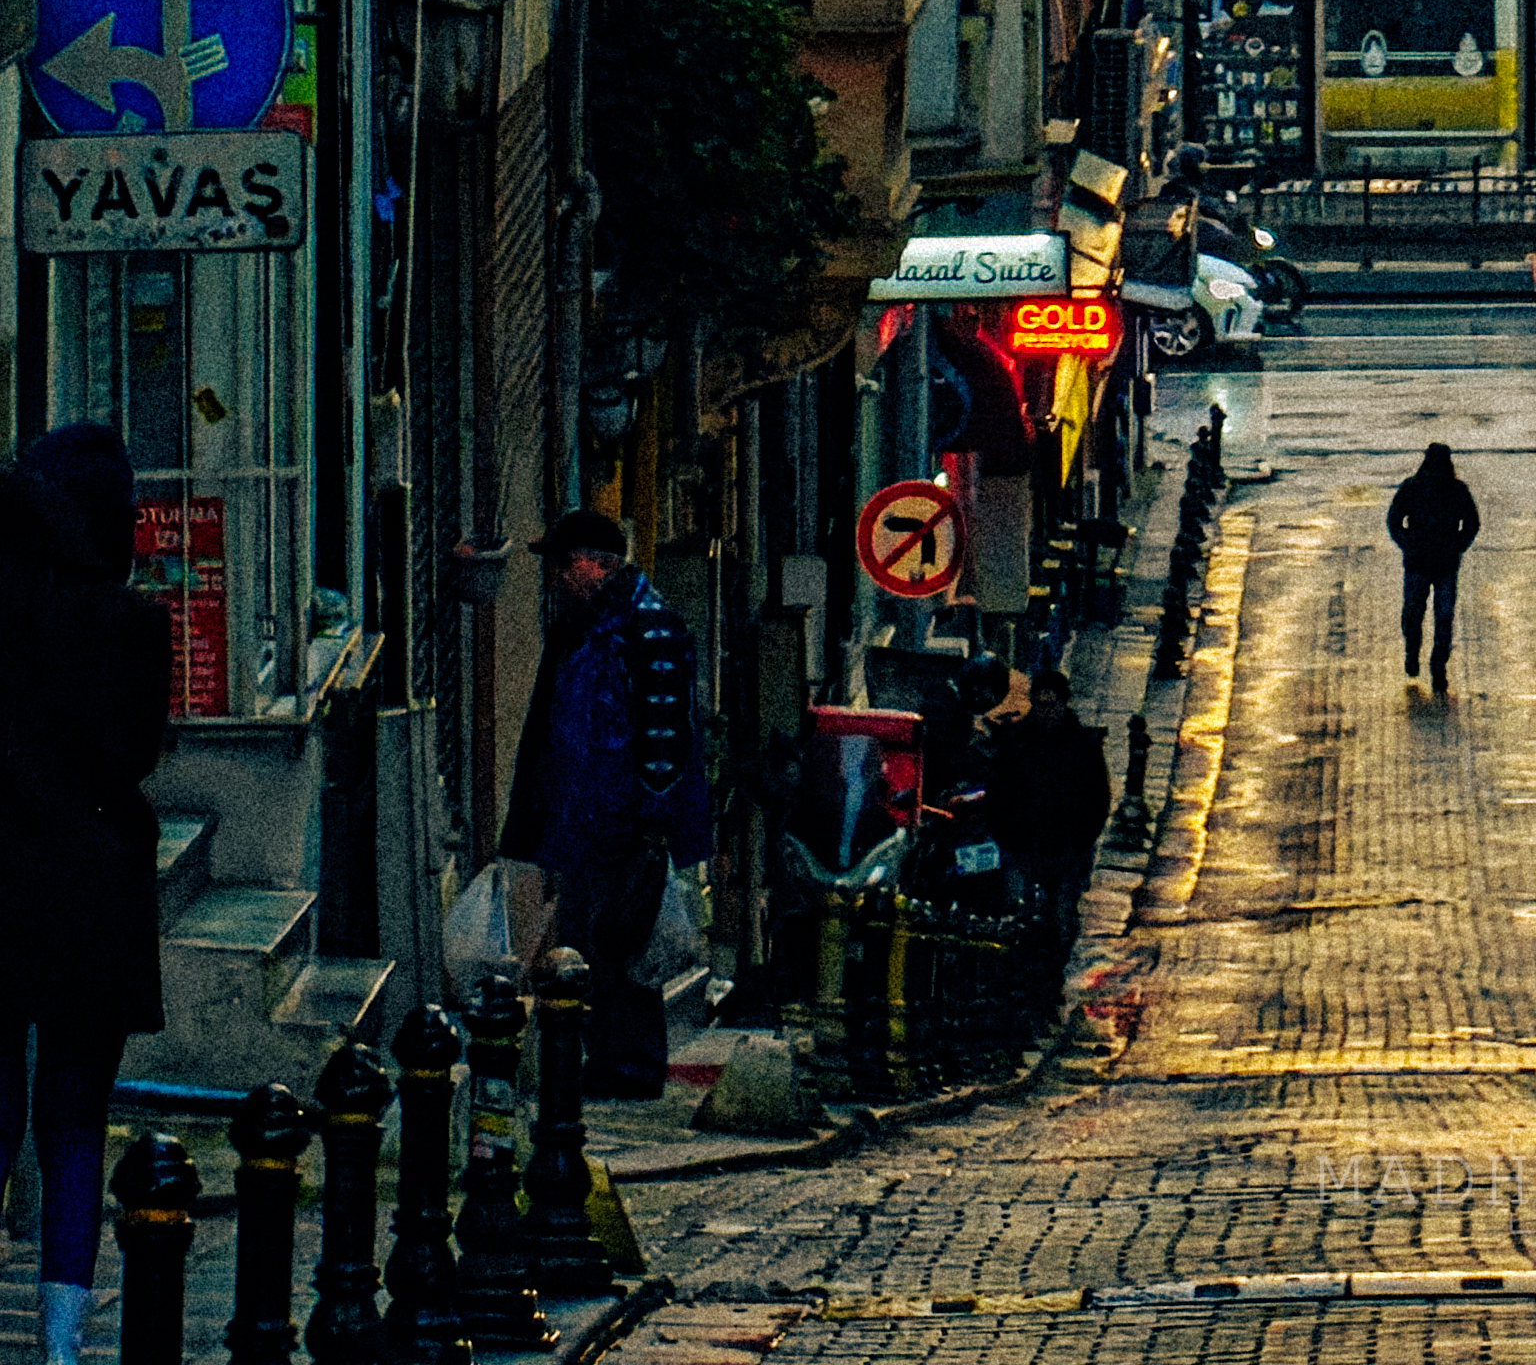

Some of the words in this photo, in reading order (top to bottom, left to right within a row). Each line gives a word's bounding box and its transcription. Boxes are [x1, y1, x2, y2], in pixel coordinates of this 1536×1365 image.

[41, 162, 284, 224] YAVAŞ
[893, 250, 966, 282] asal
[973, 251, 1057, 284] Suite
[1016, 304, 1107, 331] GOLD
